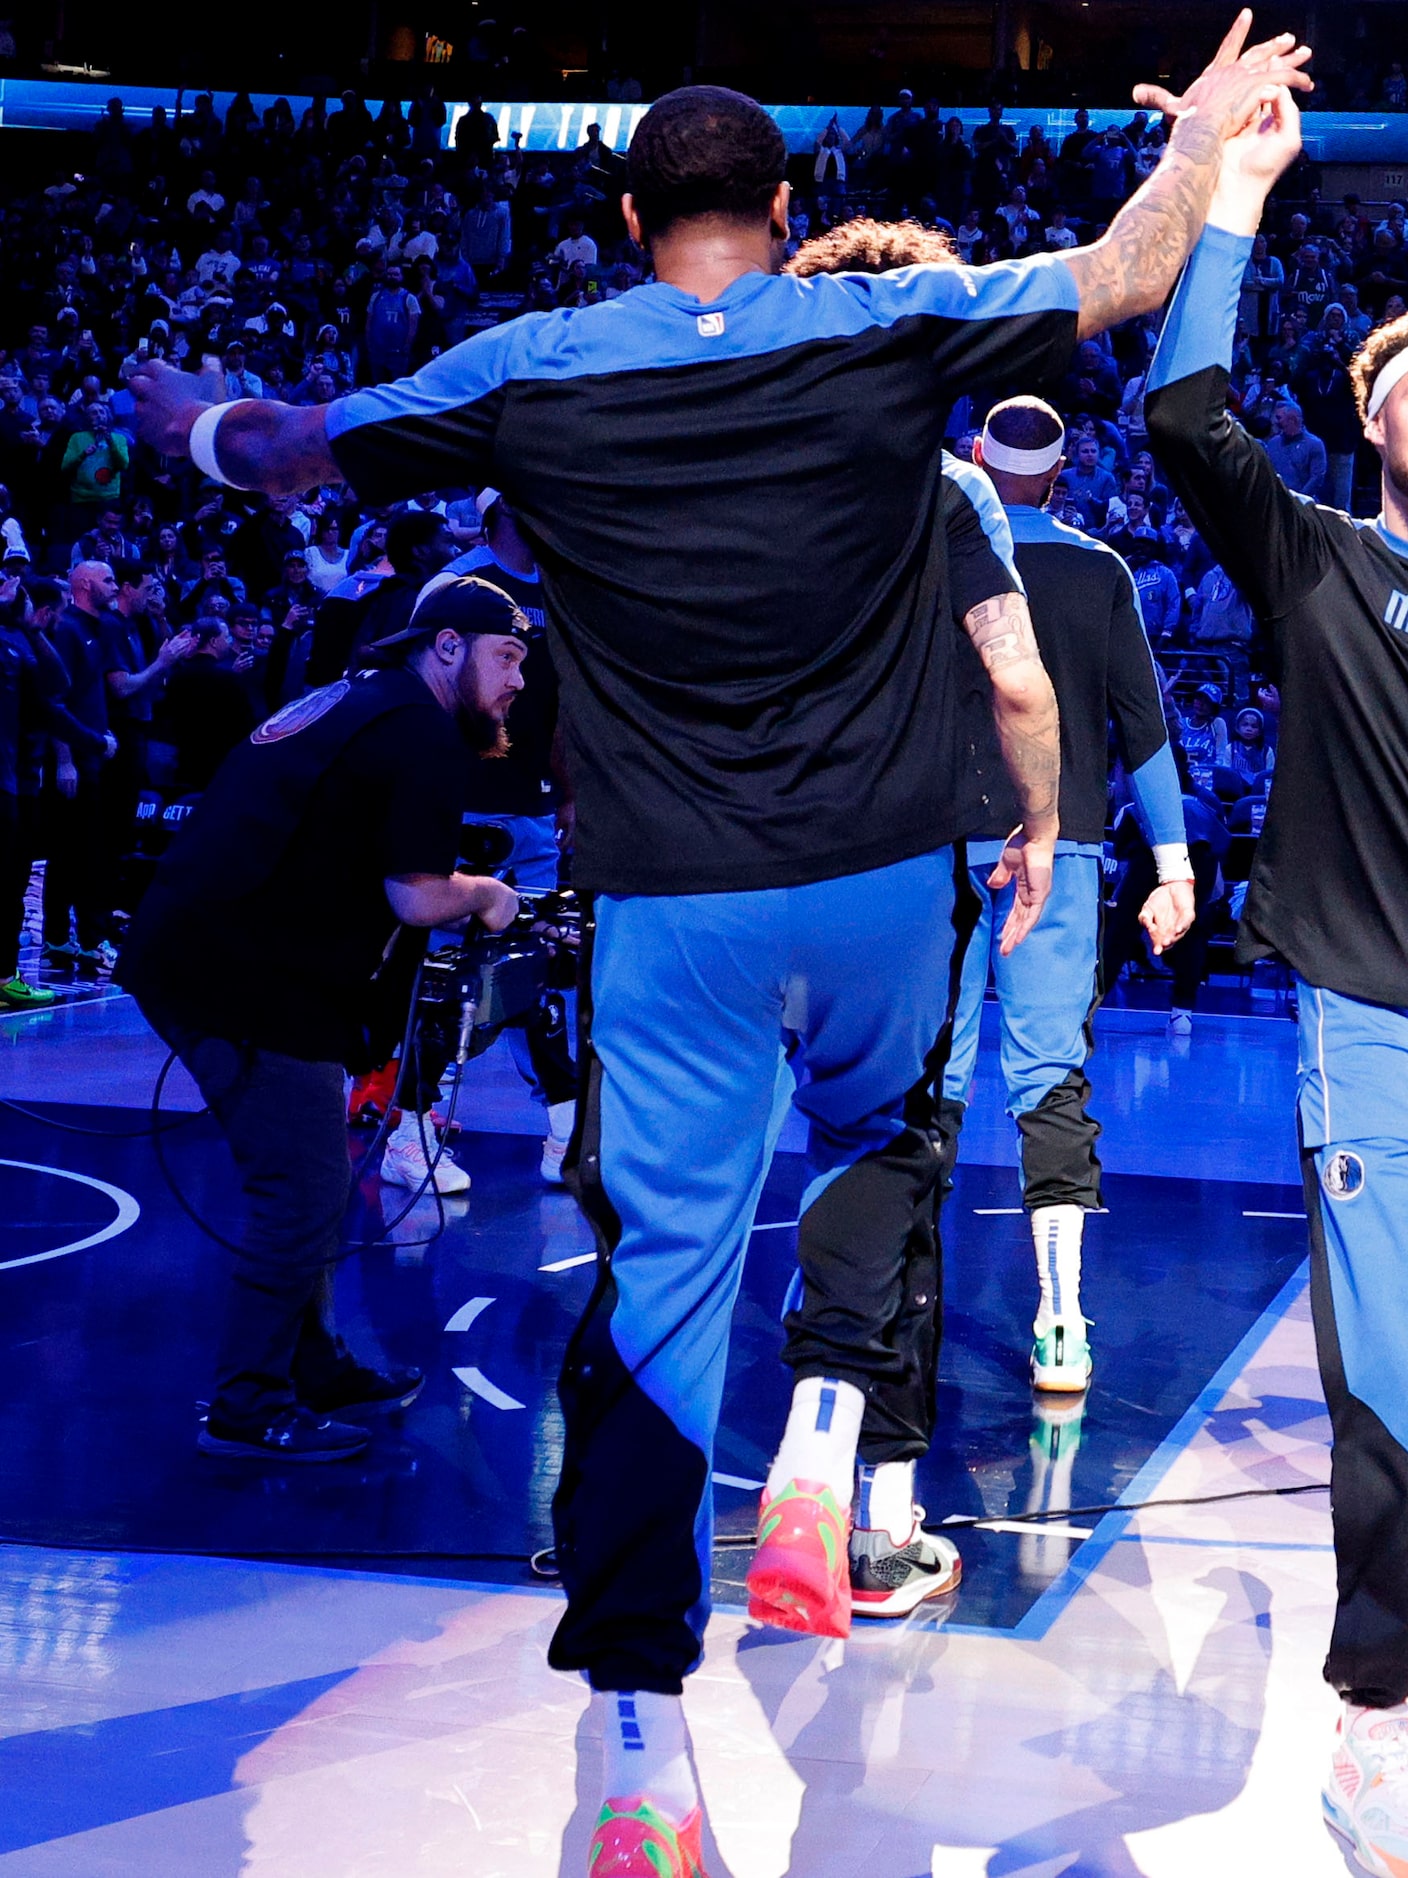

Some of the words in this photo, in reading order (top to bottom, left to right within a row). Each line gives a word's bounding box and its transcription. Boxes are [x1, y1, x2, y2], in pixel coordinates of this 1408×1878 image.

[1385, 175, 1403, 185] 117
[1315, 281, 1327, 292] 41
[162, 804, 185, 821] GET
